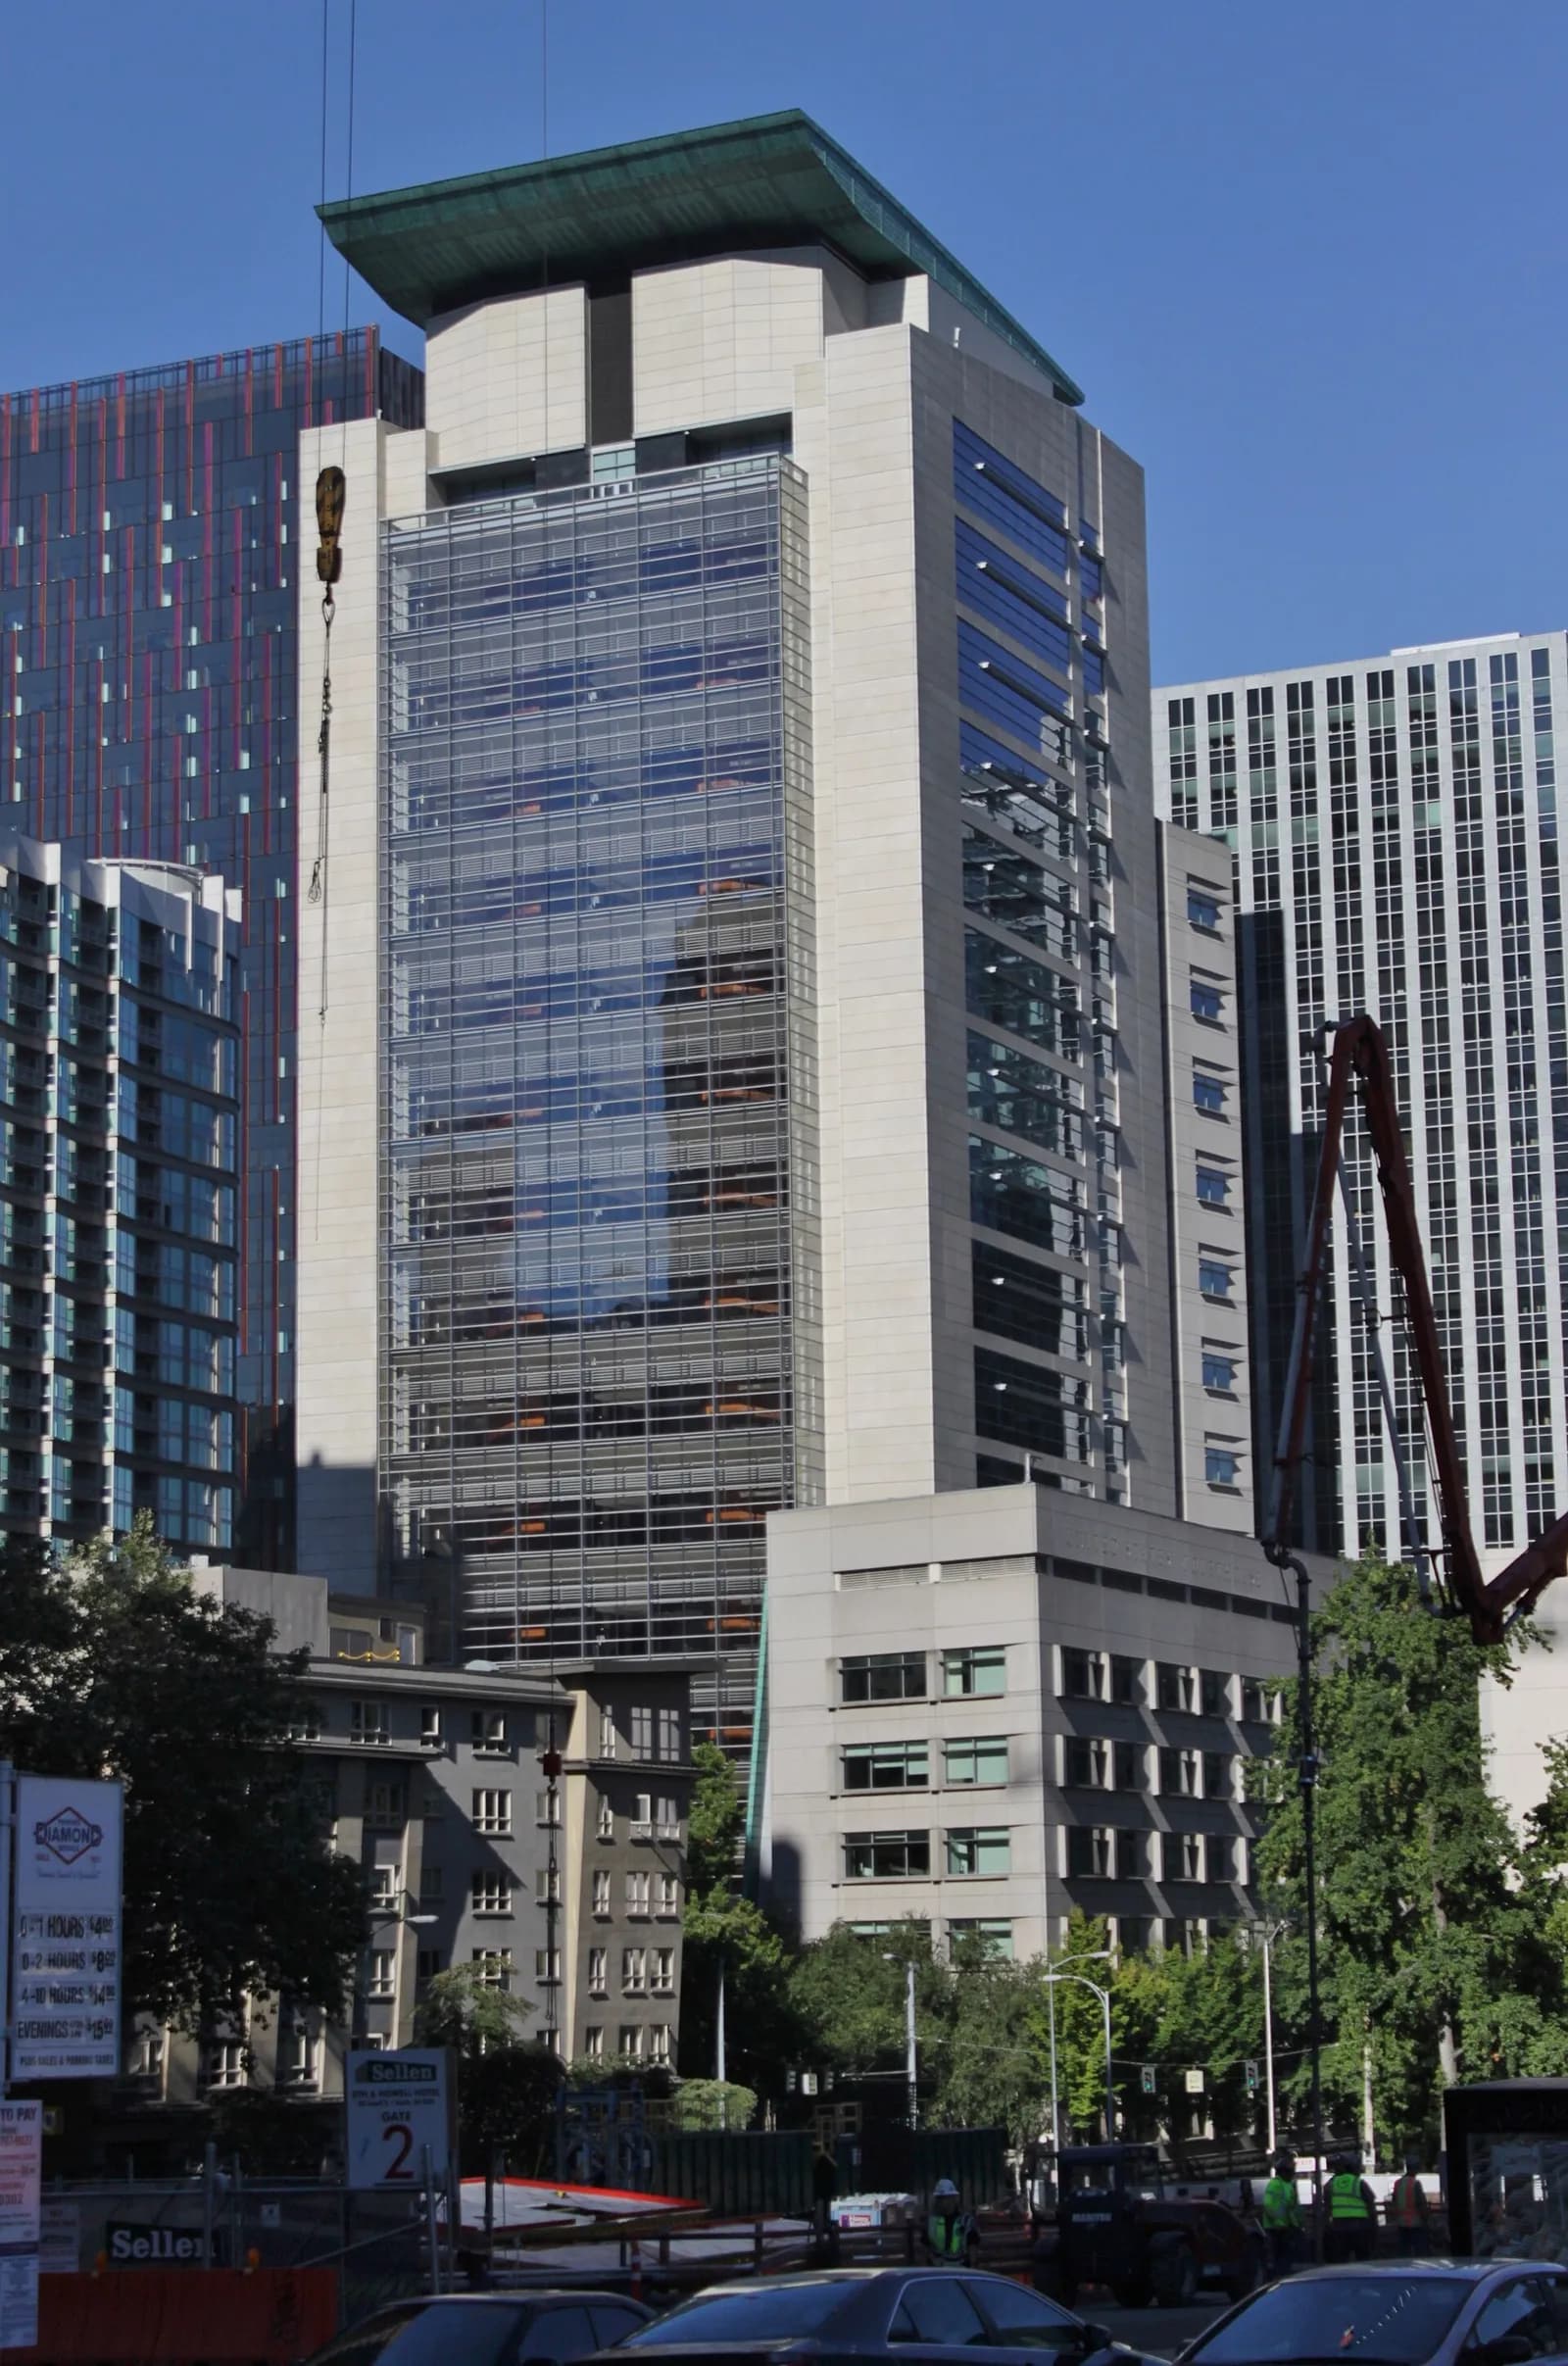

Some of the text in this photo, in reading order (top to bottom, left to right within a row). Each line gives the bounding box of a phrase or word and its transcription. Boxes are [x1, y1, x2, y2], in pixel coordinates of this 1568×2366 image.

[33, 1821, 104, 1848] DIAMOND
[47, 1914, 85, 1939] HOURS
[47, 1951, 86, 1970] HOURS
[48, 1986, 84, 2005] HOURS
[18, 2020, 69, 2040] EVENINGS
[371, 2063, 433, 2081] Sellen
[0, 2107, 37, 2121] TO PAY
[381, 2111, 412, 2123] GATE
[382, 2124, 416, 2180] 2
